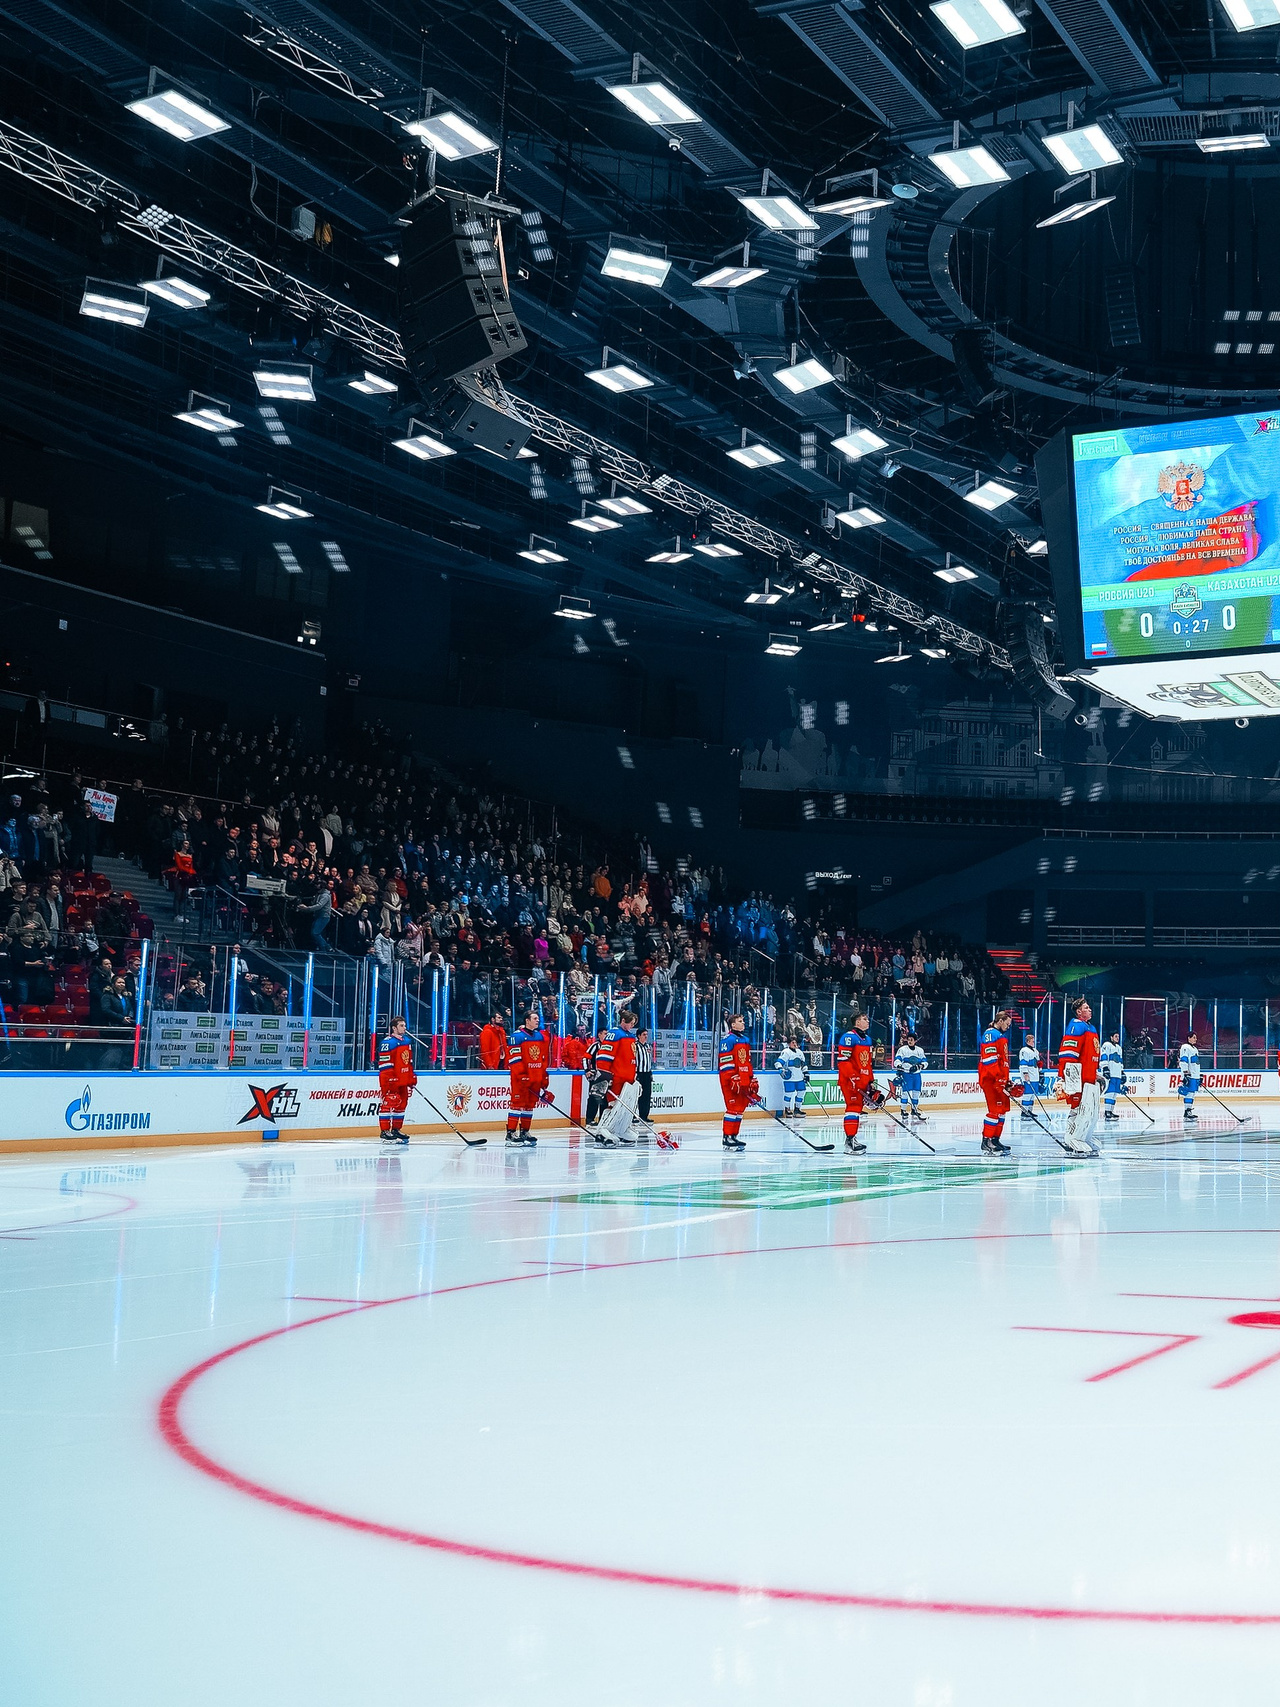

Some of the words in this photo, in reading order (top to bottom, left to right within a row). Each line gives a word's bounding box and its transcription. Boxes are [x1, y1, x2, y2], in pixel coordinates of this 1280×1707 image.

[1114, 524, 1142, 534] РОССИЯ
[1150, 520, 1194, 531] СВЯЩЕННАЯ
[1196, 517, 1218, 527] НАША
[1219, 514, 1256, 526] ДЕРЖАВА,
[1120, 534, 1148, 544] РОССИЯ
[1158, 530, 1194, 542] ЛЮБИМАЯ
[1196, 528, 1217, 538] НАША
[1218, 524, 1249, 535] СТРАНА.
[1126, 544, 1158, 554] МОГУЧАЯ
[1160, 542, 1182, 552] ВОЛЯ,
[1182, 540, 1215, 550] ВЕЛИКАЯ
[1216, 537, 1240, 546] СЛАВА
[1124, 554, 1142, 566] ТВОЁ
[1142, 552, 1185, 565] ДОСТОЯНЬЕ
[1186, 551, 1196, 560] НА
[1198, 549, 1212, 560] ВСЕ
[1212, 547, 1248, 558] ВРЕМЕНА!
[1207, 578, 1264, 592] КАЗАХСТАН
[1099, 588, 1134, 602] РОССИЯ
[1137, 587, 1154, 598] U20
[1140, 612, 1154, 638] 0
[1222, 605, 1236, 630] 0
[1173, 619, 1210, 635] 0:27
[606, 1032, 615, 1040] 20
[985, 1034, 992, 1042] 31
[381, 1043, 389, 1051] 23
[309, 1088, 346, 1100] ХОККЕЙ
[347, 1090, 353, 1099] В
[236, 1082, 301, 1125] XHL
[90, 1112, 150, 1131] ГАЗПРОМ
